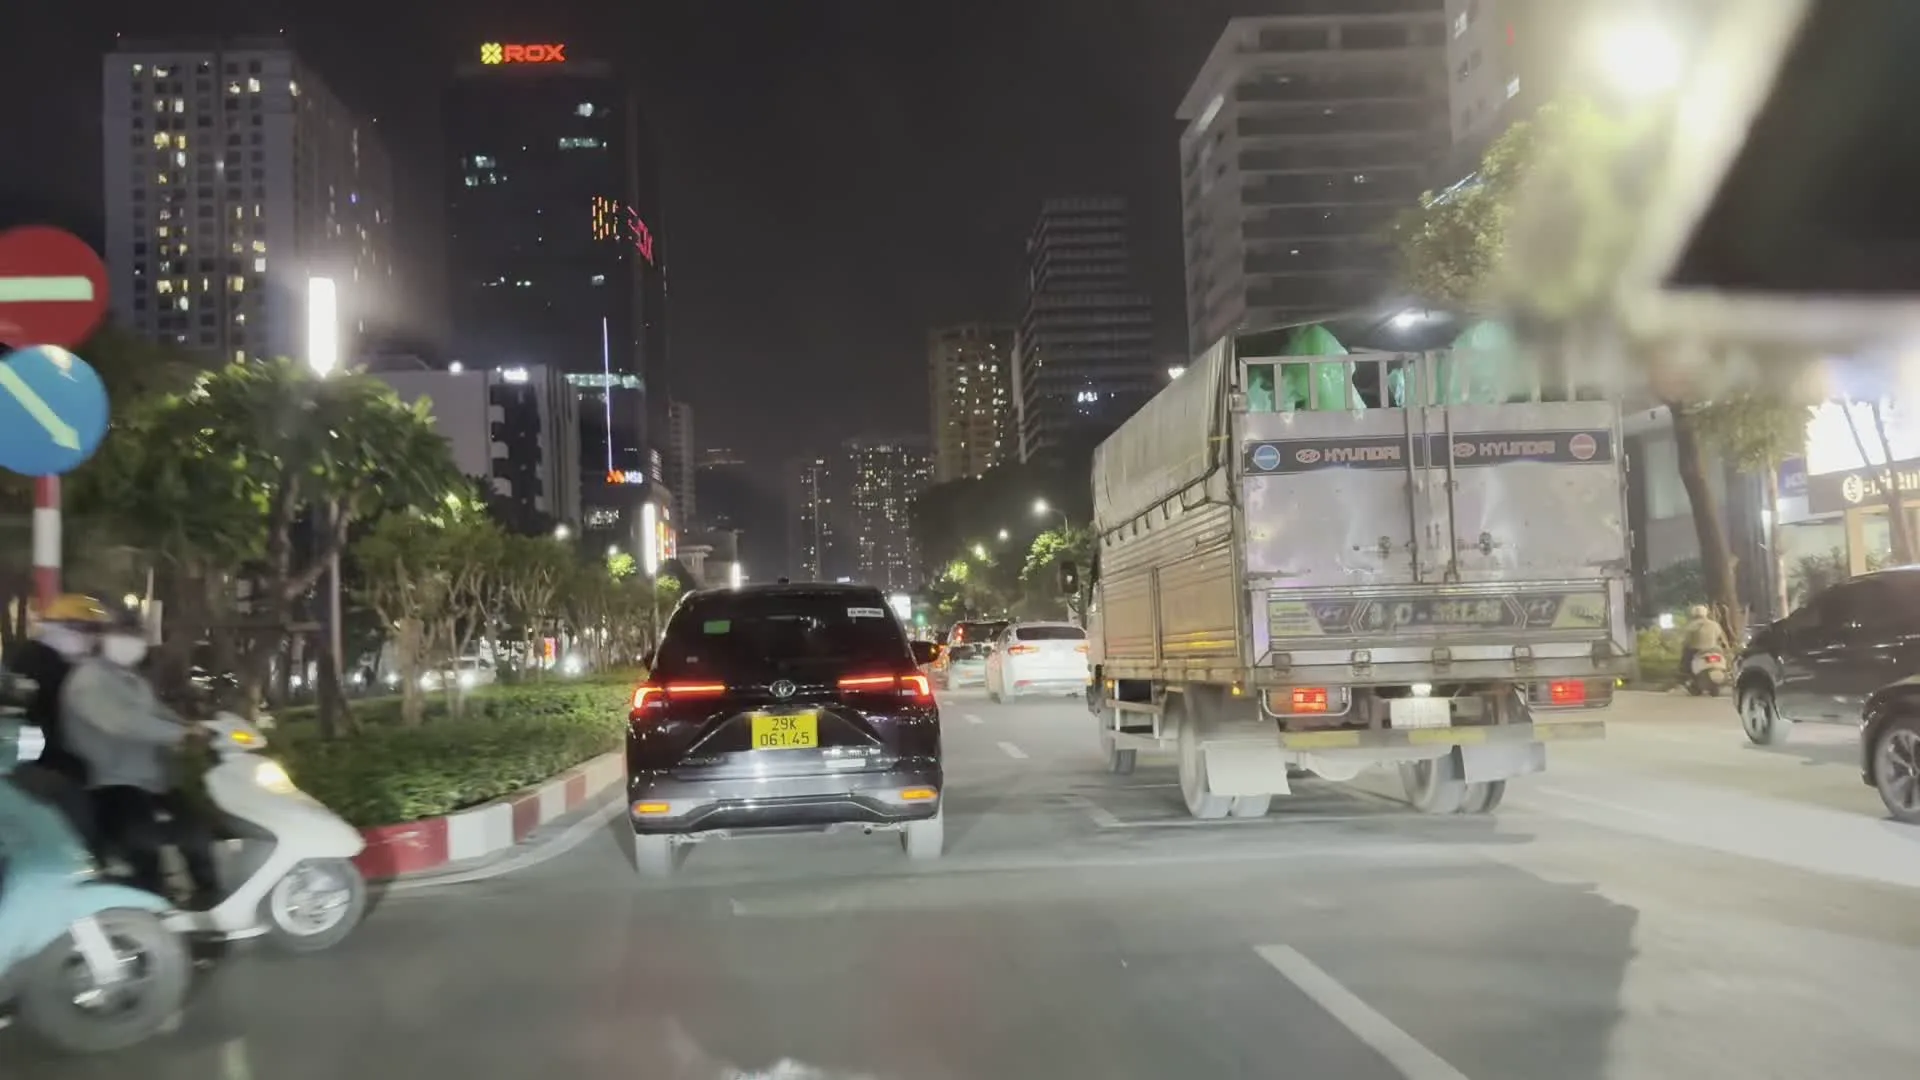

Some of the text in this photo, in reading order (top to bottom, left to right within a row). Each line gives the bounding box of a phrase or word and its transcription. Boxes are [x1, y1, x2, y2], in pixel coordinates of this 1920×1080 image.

[504, 44, 565, 62] ROX
[1324, 446, 1401, 462] HYUNDAI
[1480, 440, 1556, 456] HYUNDAI
[771, 717, 797, 731] 29K
[760, 731, 810, 746] 061.45
